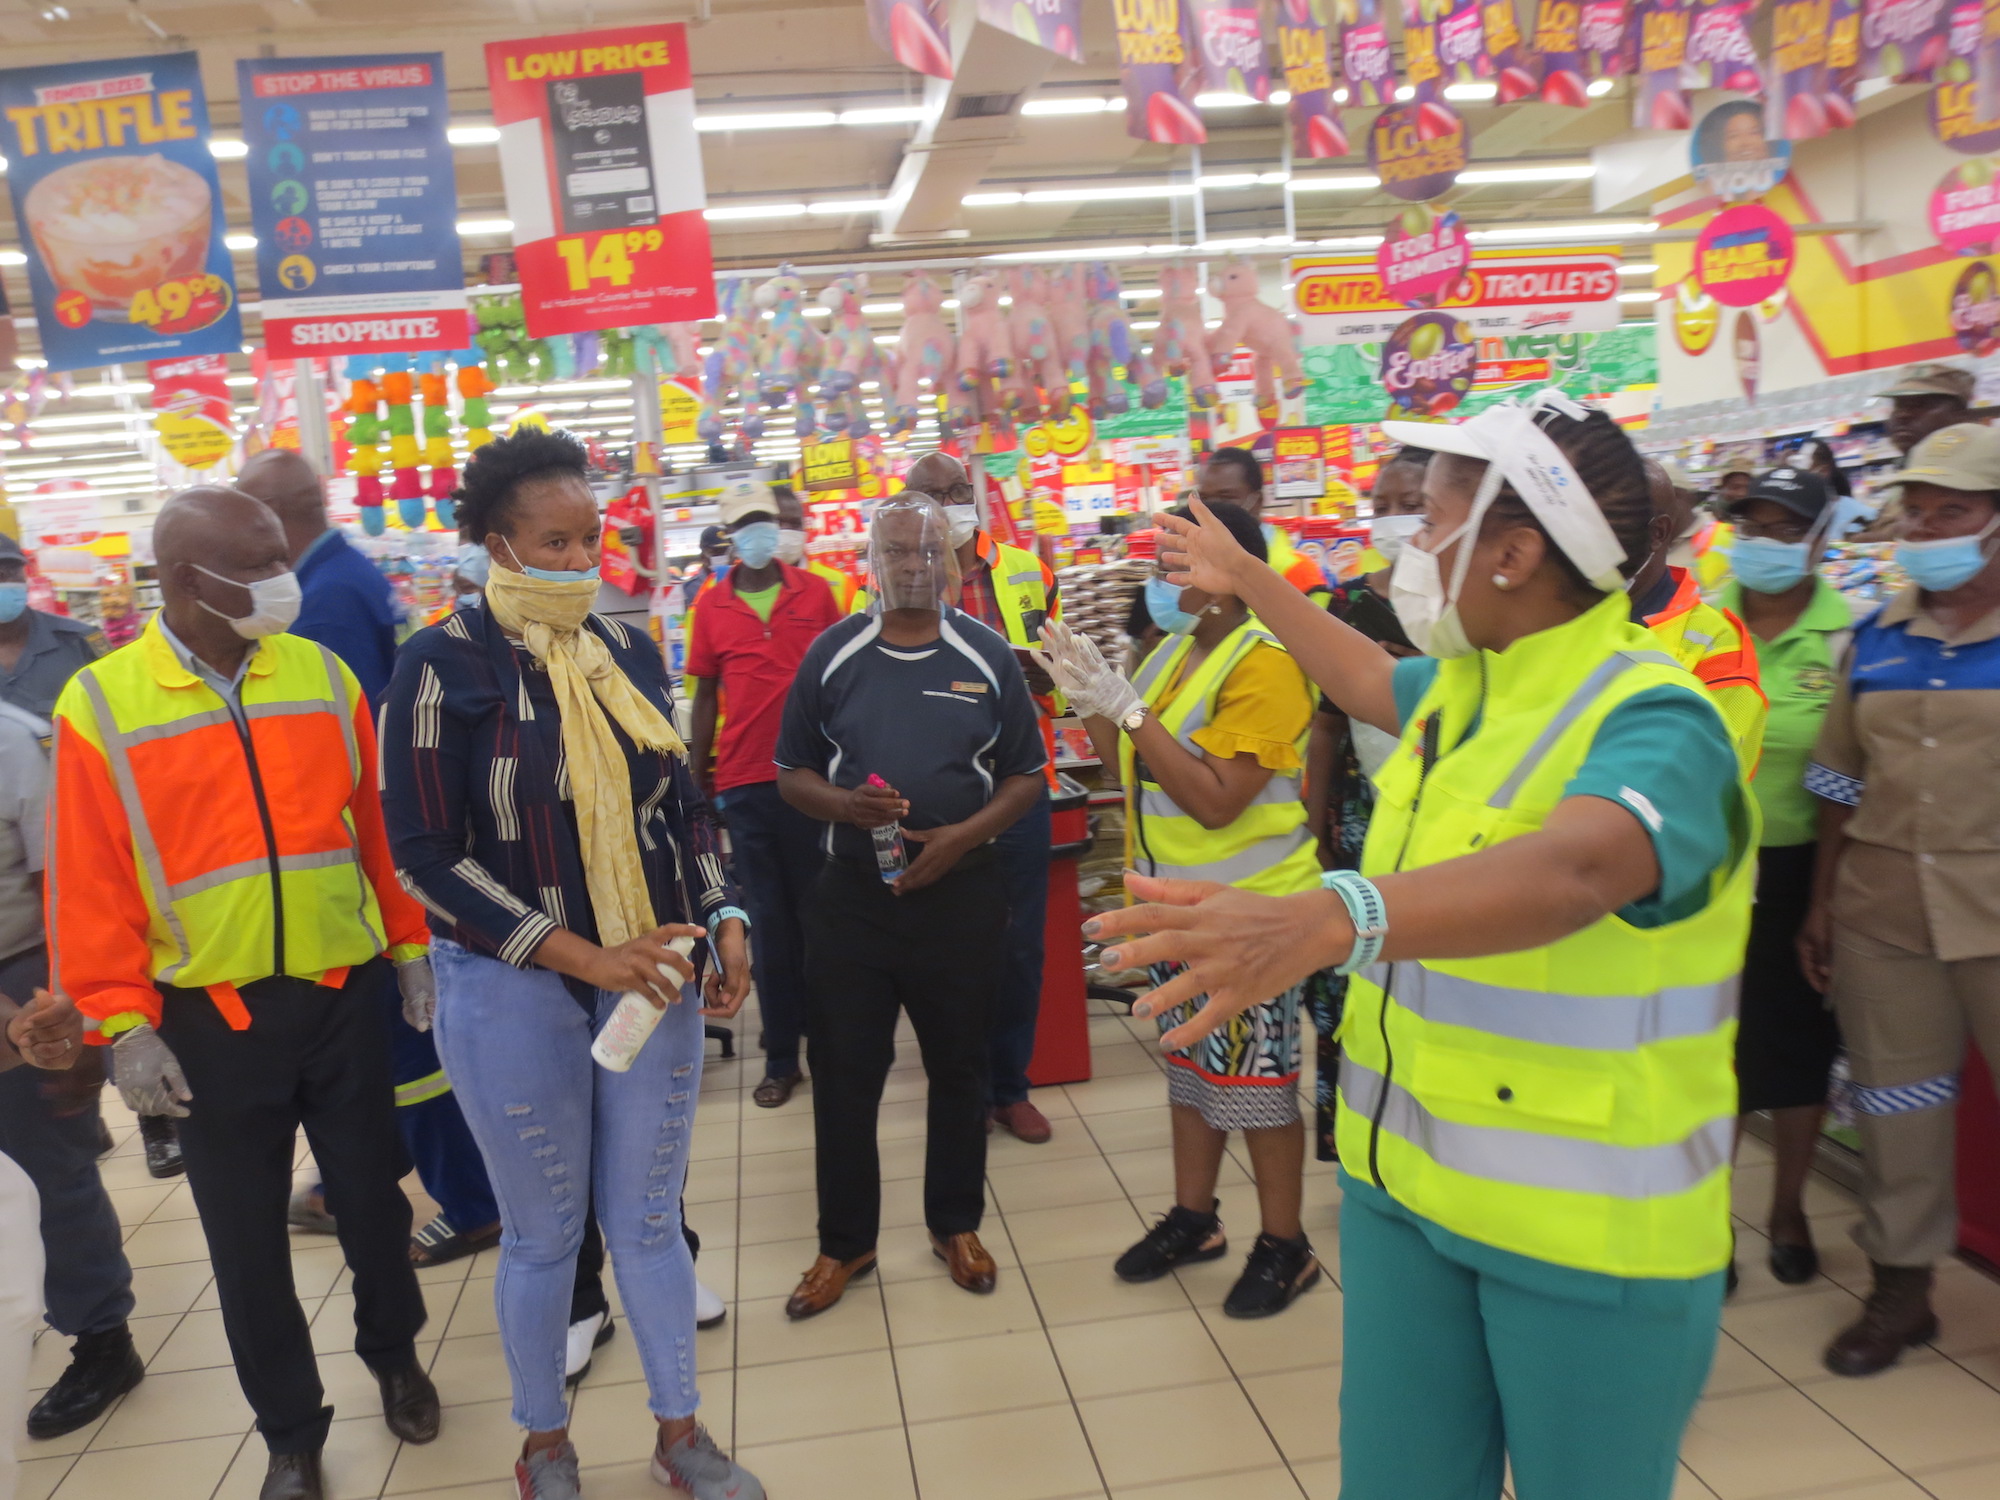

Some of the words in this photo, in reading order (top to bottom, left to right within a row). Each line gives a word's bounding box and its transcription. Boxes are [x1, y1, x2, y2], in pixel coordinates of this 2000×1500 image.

[505, 51, 577, 82] LOW
[579, 40, 671, 74] PRICE
[262, 75, 316, 96] STOP
[319, 71, 361, 90] THE
[362, 66, 423, 87] VIRUS
[6, 89, 197, 157] TRIFLE
[1379, 147, 1467, 185] PRICES
[1391, 232, 1436, 262] FOR
[1438, 227, 1455, 248] A
[1386, 244, 1465, 285] FAMILY
[1484, 270, 1614, 299] TROLLEYS
[291, 316, 441, 346] SHOPRITE
